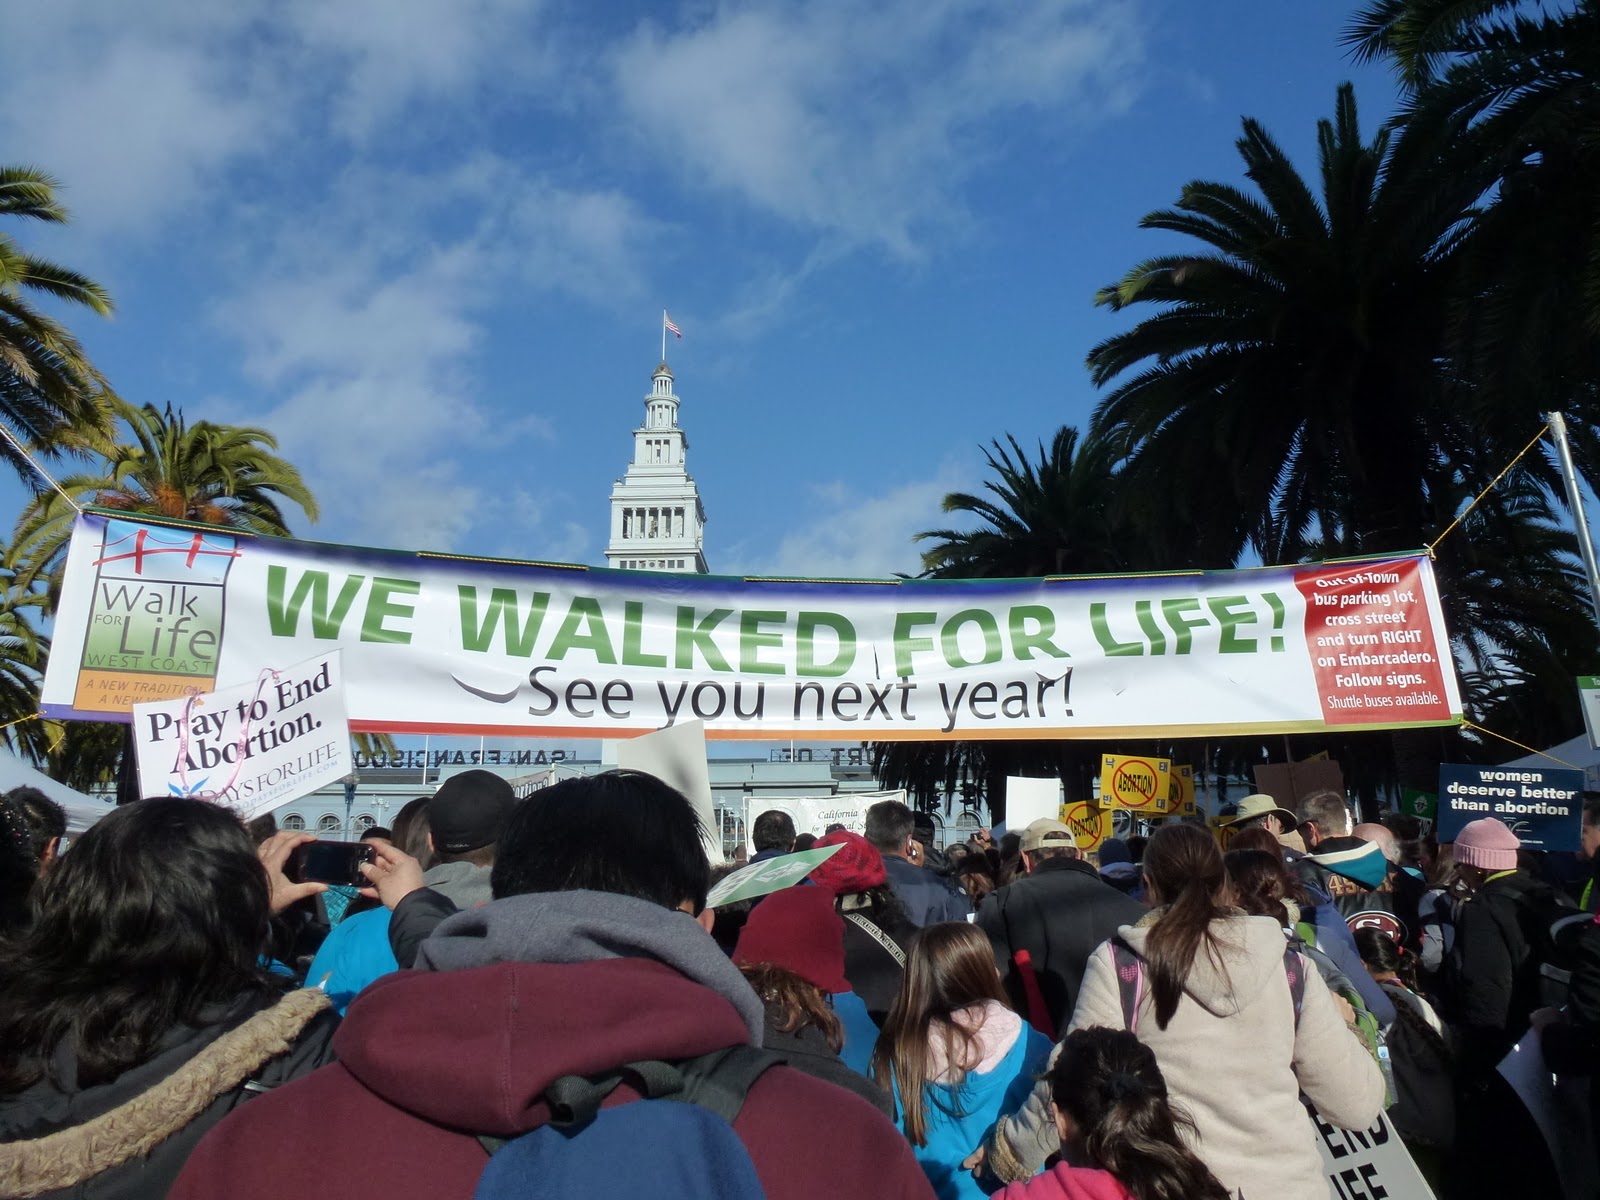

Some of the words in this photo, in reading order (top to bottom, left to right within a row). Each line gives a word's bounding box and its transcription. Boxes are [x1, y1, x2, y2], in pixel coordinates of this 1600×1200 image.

[1315, 572, 1399, 588] Out-of-Town
[103, 583, 198, 618] Walk
[1313, 592, 1338, 606] bus
[1340, 591, 1391, 608] parking
[1393, 590, 1418, 604] lot,
[267, 564, 421, 644] WE
[458, 585, 857, 677] WALKED
[894, 605, 1071, 677] FOR
[1090, 593, 1286, 656] LIFE!
[1325, 615, 1361, 626] cross
[1366, 611, 1407, 624] street
[95, 614, 122, 625] FOR
[119, 616, 216, 660] Life
[1317, 632, 1344, 647] and
[1348, 633, 1378, 645] turn
[1381, 630, 1422, 643] RIGHT
[88, 653, 143, 668] WEST
[150, 658, 213, 672] COAST
[1317, 656, 1336, 667] on
[1339, 650, 1436, 666] Embarcadero.
[85, 680, 94, 689] A
[99, 680, 129, 691] NEW
[1335, 673, 1382, 688] Follow
[1386, 672, 1426, 688] signs.
[98, 695, 107, 704] A
[236, 700, 268, 723] to
[274, 662, 332, 713] End
[528, 666, 634, 718] See
[656, 679, 765, 730] you
[794, 677, 917, 722] next
[939, 667, 1074, 733] year!
[1327, 694, 1363, 709] Shuttle
[1364, 693, 1393, 707] buses
[1395, 691, 1442, 706] available.
[169, 712, 323, 774] Abortion.
[257, 762, 296, 792] FOR
[297, 741, 337, 773] LIFE
[1117, 773, 1153, 794] ABORTION
[1479, 771, 1543, 784] women
[1447, 782, 1516, 797] deserve
[1521, 785, 1576, 800] better
[818, 809, 858, 822] California
[1451, 798, 1490, 811] than
[1494, 801, 1569, 816] abortion
